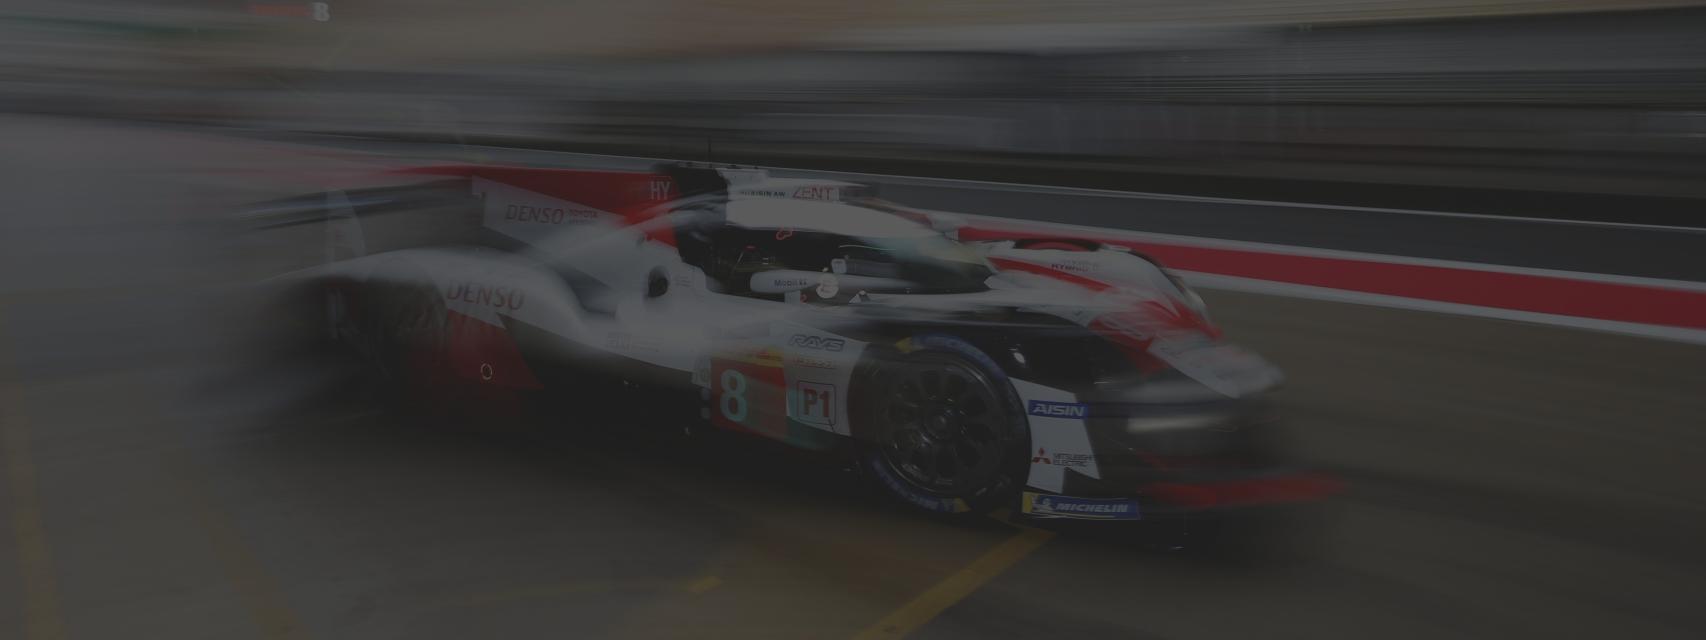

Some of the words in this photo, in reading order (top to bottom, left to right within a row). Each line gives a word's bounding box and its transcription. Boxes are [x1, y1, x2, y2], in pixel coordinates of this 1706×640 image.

[650, 180, 671, 200] HY
[792, 185, 832, 200] ZENT
[505, 204, 565, 225] DENSO
[446, 281, 526, 311] DENSO
[788, 333, 846, 353] RAYS
[719, 368, 748, 422] 8
[802, 388, 830, 418] P1
[1031, 403, 1086, 417] AISIN
[1055, 502, 1129, 514] MICHELIN
